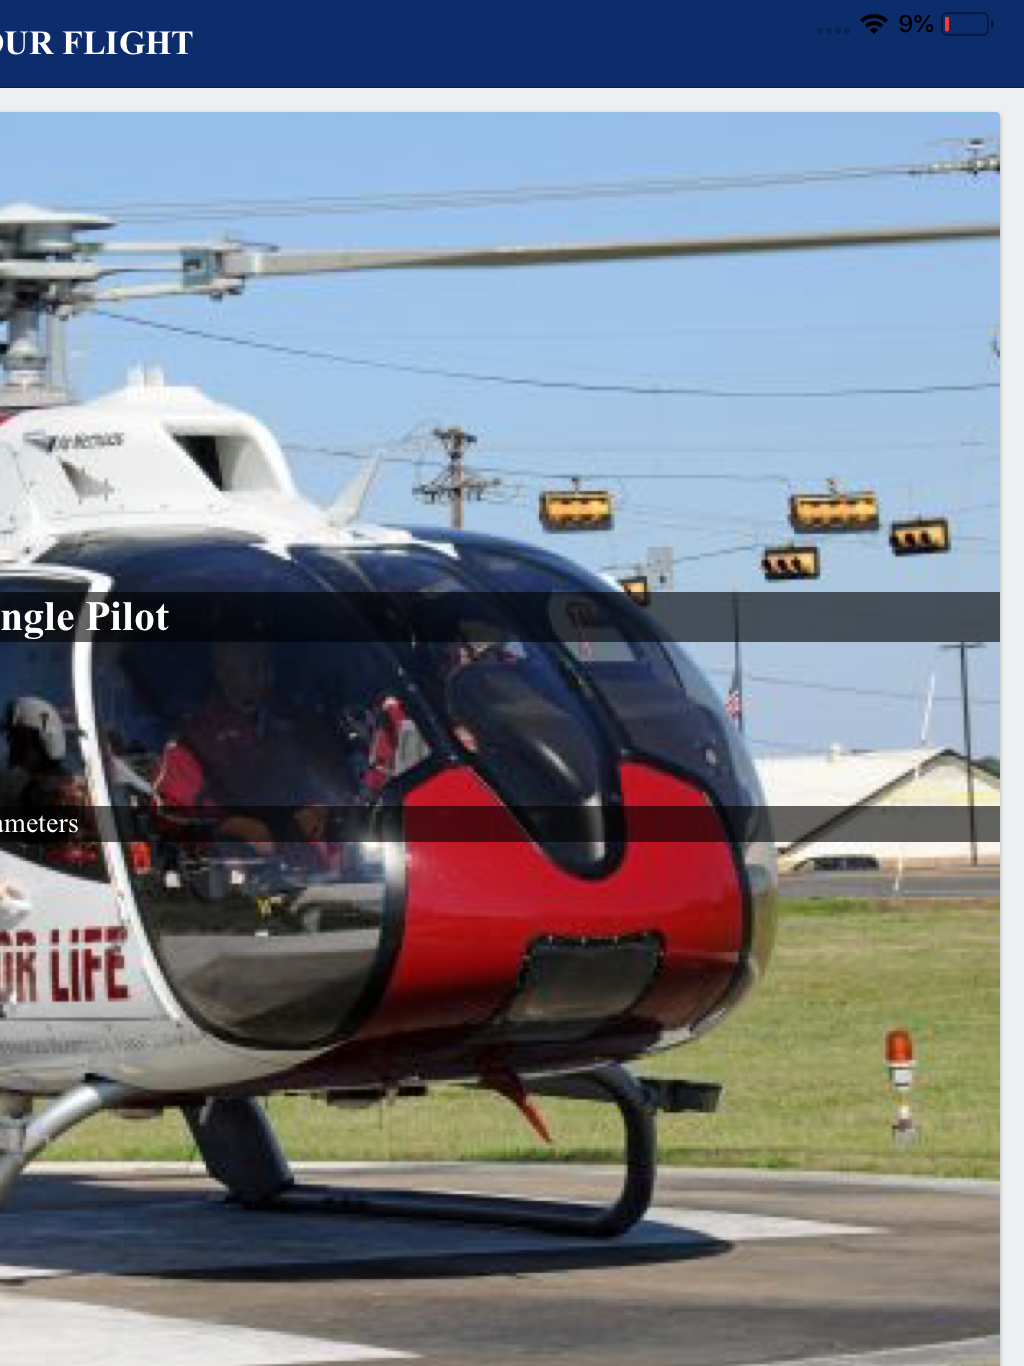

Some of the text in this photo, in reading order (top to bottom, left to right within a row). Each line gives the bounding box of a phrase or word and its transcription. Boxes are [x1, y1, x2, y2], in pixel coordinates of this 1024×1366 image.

[898, 14, 934, 33] 9%
[62, 30, 193, 56] FLIGHT
[49, 926, 129, 1003] LIFE
